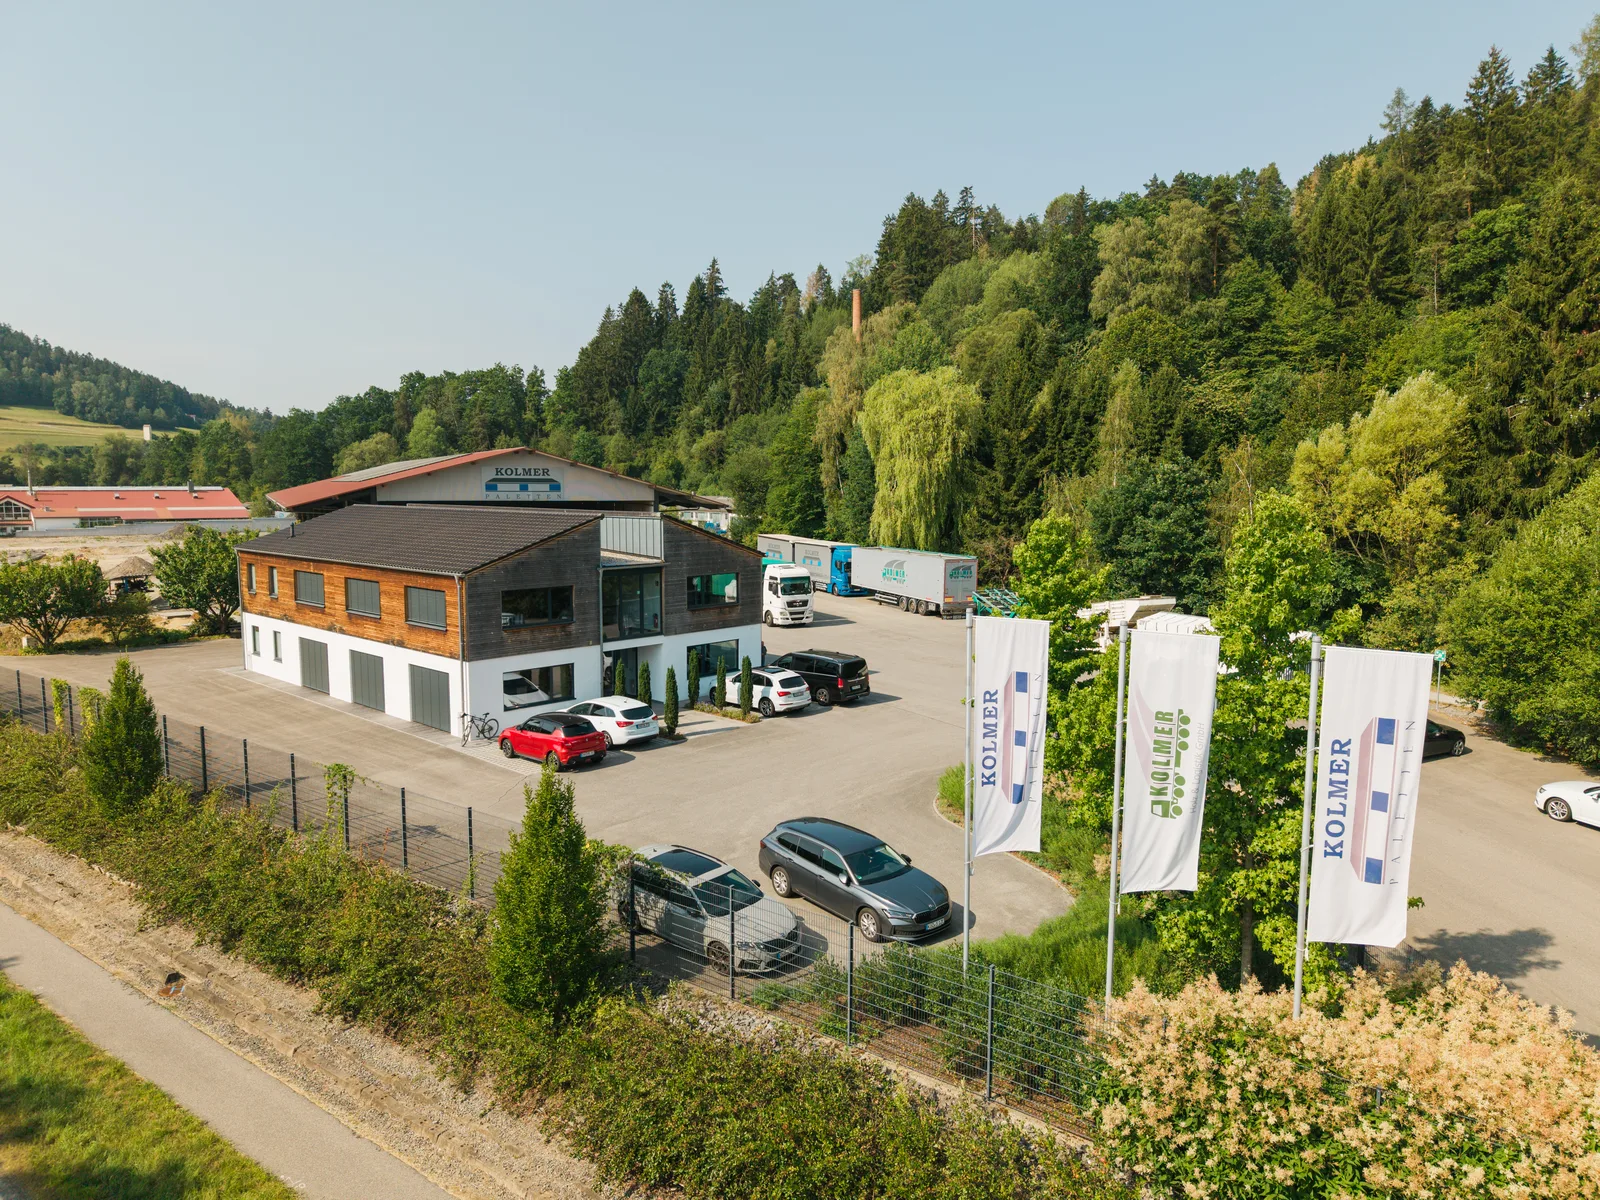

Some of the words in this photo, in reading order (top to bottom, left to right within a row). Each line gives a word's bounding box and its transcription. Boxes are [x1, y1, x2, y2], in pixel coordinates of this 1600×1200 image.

[495, 467, 550, 476] KOLMER
[981, 689, 998, 787] KOLMER
[1149, 710, 1174, 796] KOLMER
[1195, 722, 1205, 751] GmbH
[1192, 752, 1203, 785] Logistik
[1323, 738, 1351, 859] KOLMER
